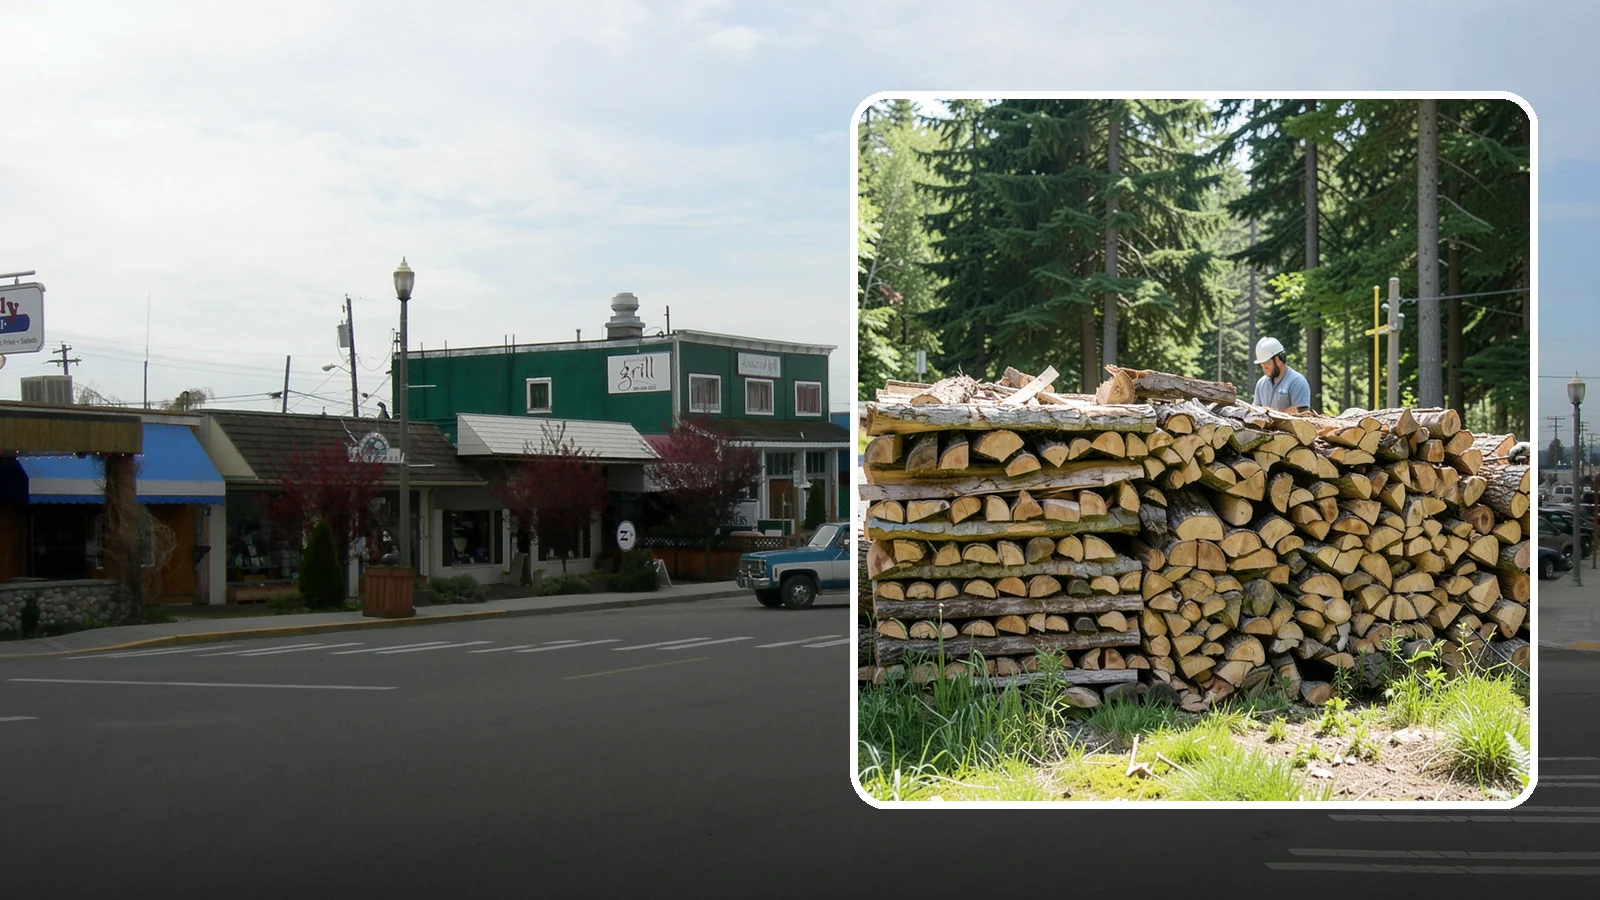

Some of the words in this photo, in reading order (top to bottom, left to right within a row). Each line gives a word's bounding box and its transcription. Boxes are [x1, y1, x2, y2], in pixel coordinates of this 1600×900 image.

[0, 297, 19, 324] ly
[20, 337, 38, 345] Salads
[617, 356, 655, 391] grill
